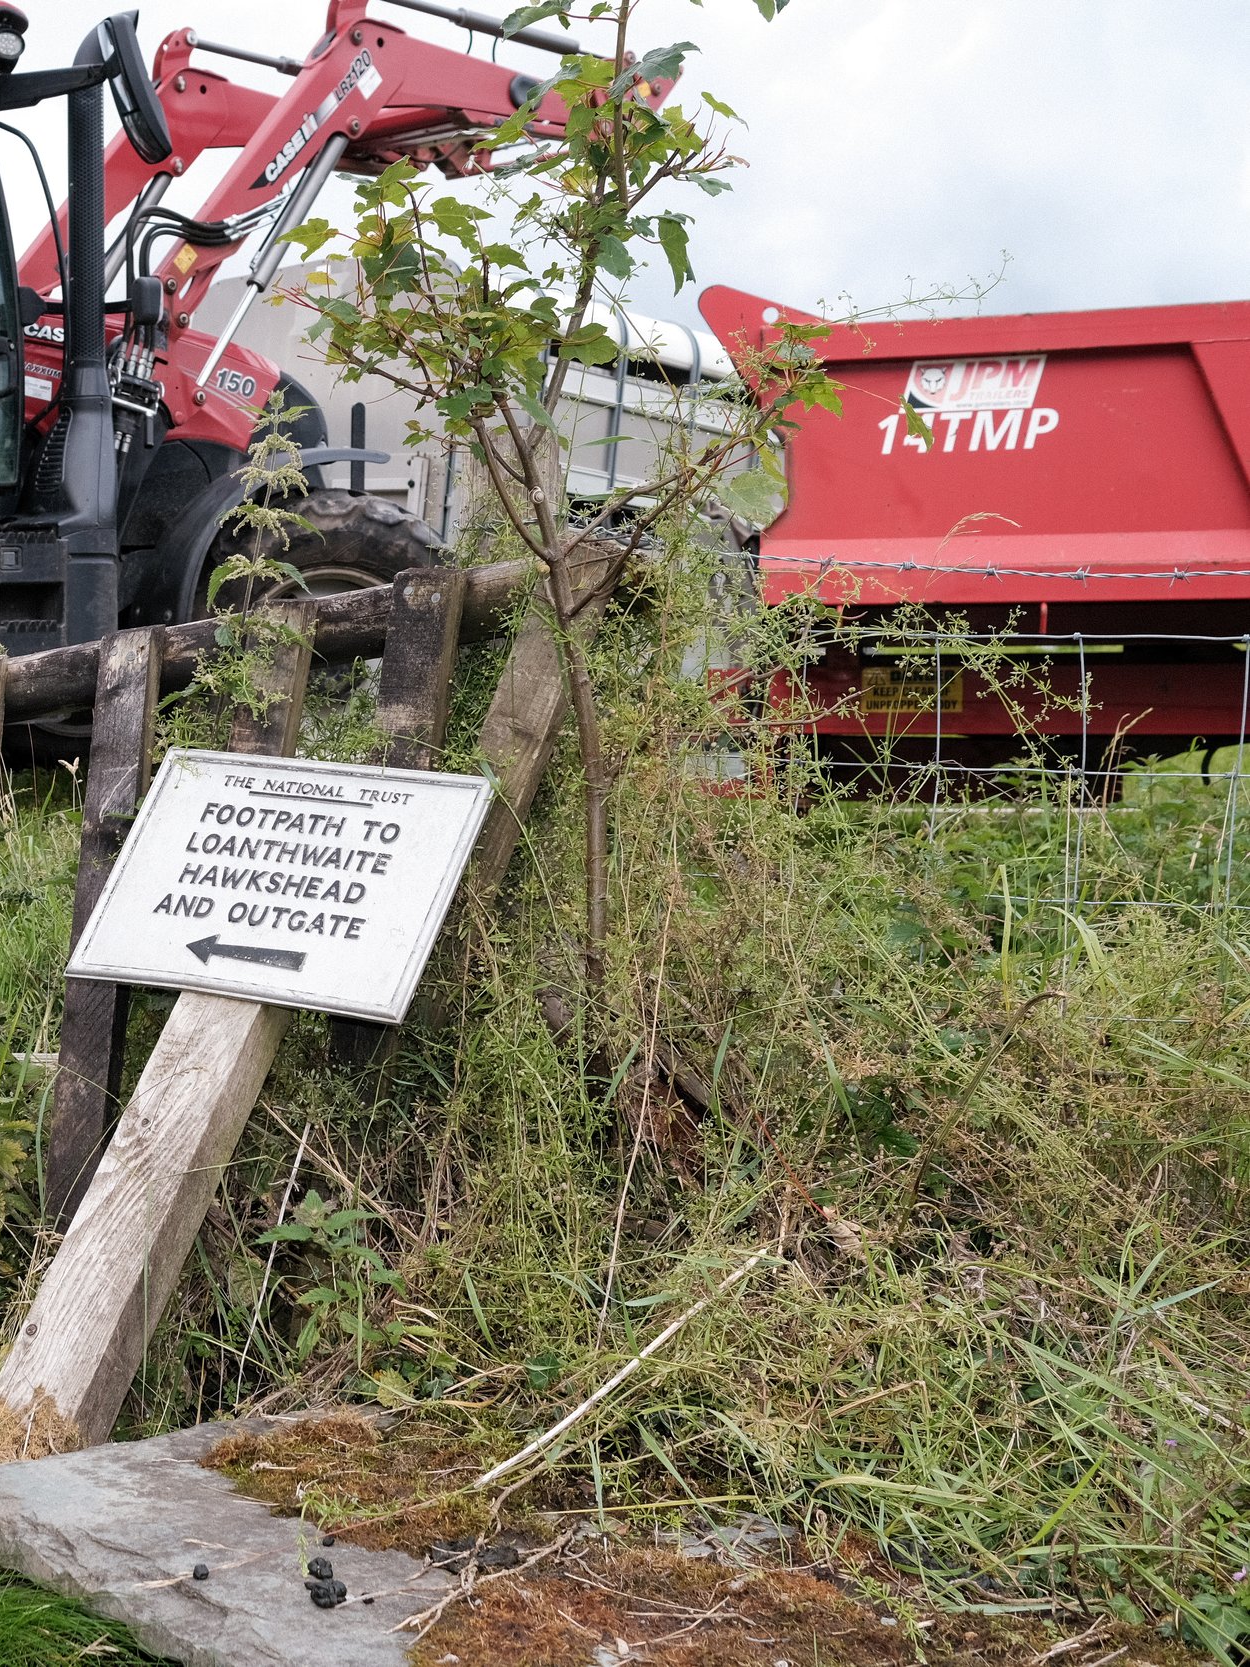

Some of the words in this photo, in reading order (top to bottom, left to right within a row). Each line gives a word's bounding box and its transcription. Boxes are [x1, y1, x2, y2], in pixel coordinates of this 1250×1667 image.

[264, 128, 307, 182] CASE
[24, 323, 65, 342] CAS
[24, 361, 62, 379] AXXUM
[217, 368, 256, 399] 150
[950, 359, 1041, 401] JPM
[970, 388, 1029, 400] TRAILERS
[866, 700, 928, 710] UNPROPPE
[873, 686, 899, 696] KEEP
[224, 774, 255, 789] THE
[263, 779, 345, 798] NATIONAL
[359, 788, 415, 806] TRUST
[200, 802, 348, 838] FOOTPATH
[363, 820, 401, 844] TO
[185, 831, 393, 875] LOANTHWAITE
[178, 862, 367, 904] HAWKSHEAD
[153, 893, 215, 919] AND
[227, 901, 366, 940] OUTGATE
